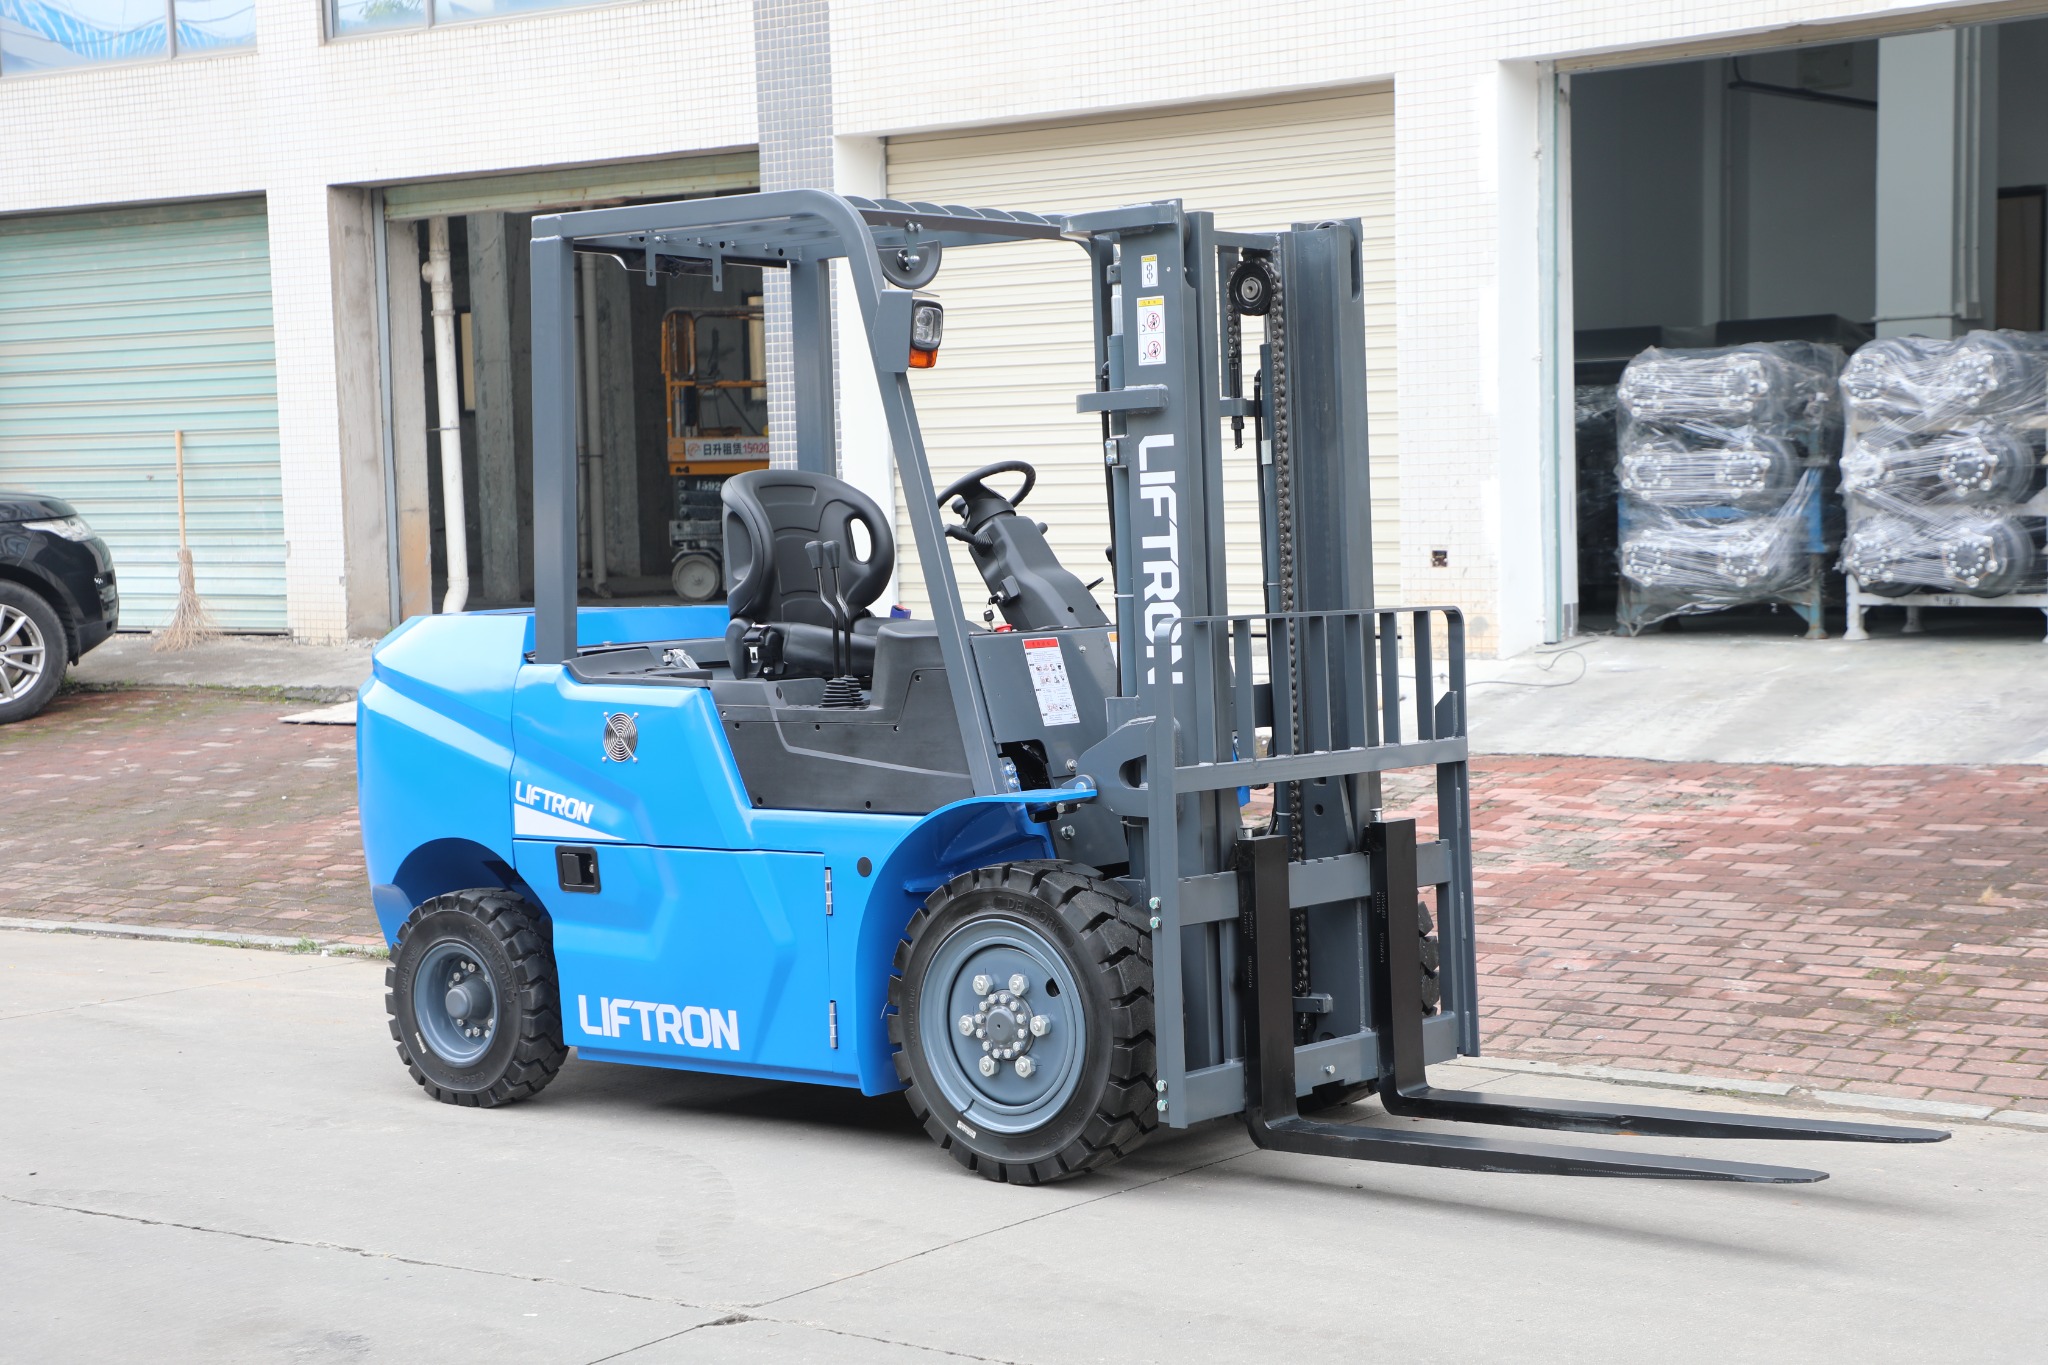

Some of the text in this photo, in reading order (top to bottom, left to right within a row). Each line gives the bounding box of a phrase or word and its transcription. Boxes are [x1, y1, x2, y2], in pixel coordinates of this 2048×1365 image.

[703, 442, 742, 456] 日升租赁
[696, 481, 722, 491] 1592
[515, 780, 594, 824] LIFTRON
[1007, 897, 1063, 933] DELIFORK
[578, 994, 740, 1051] LIFTRON
